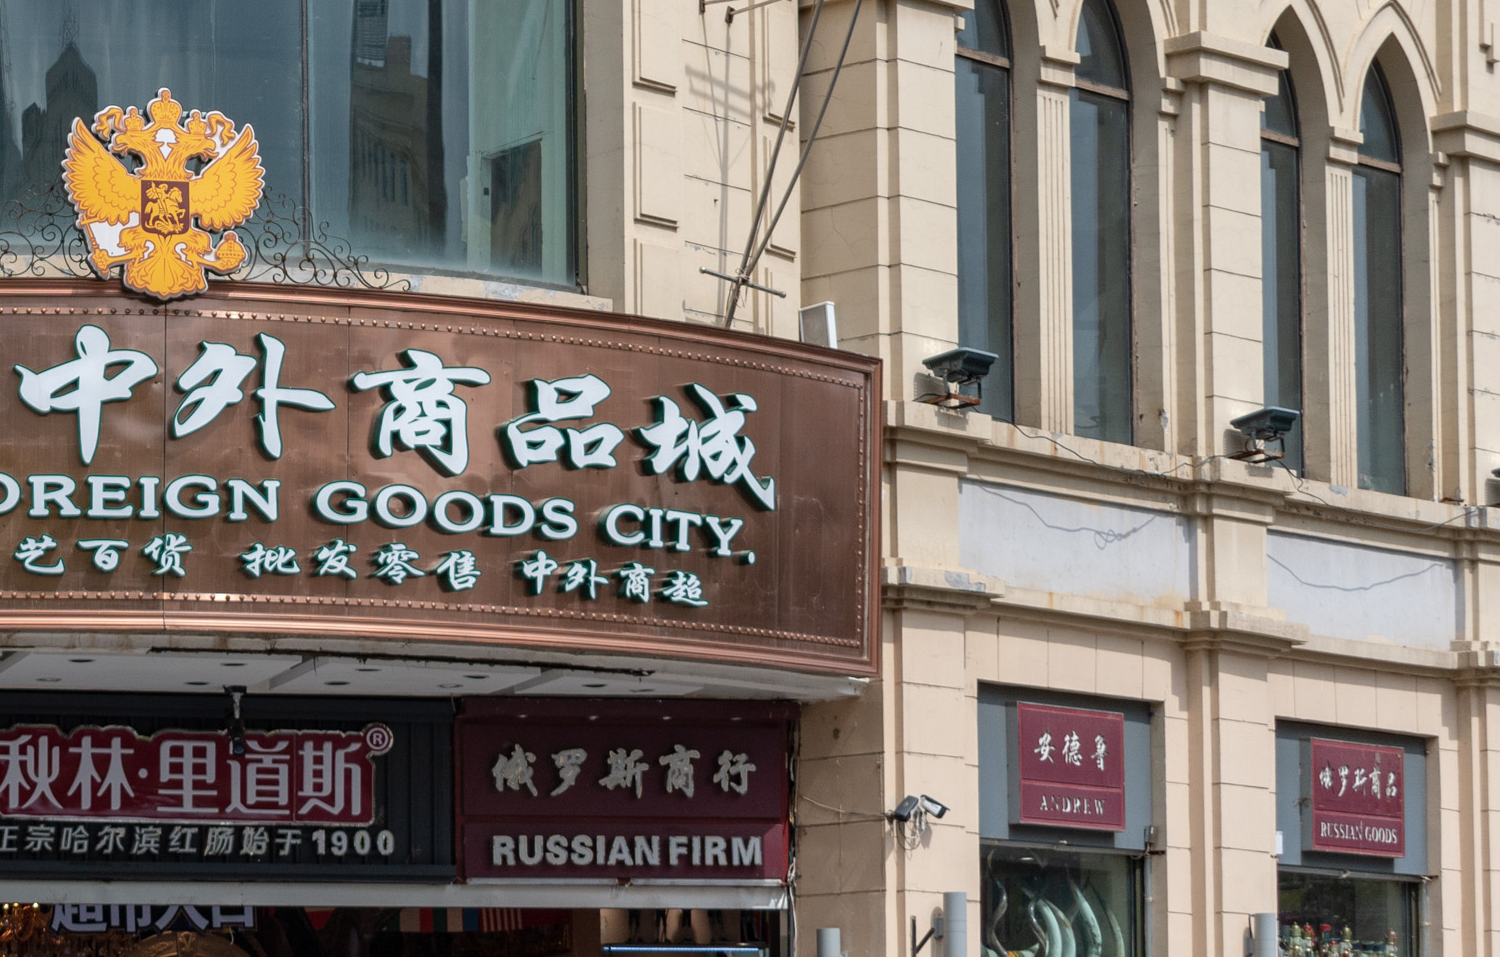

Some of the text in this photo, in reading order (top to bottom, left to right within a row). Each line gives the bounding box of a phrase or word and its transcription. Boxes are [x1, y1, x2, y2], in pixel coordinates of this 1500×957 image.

[314, 481, 579, 540] GOODS
[242, 540, 482, 592] 批发零售
[520, 549, 710, 607] 中外商超
[1033, 730, 1109, 772] 安德鲁
[491, 743, 757, 799] 俄罗斯商行
[1318, 764, 1398, 800] 俄罗斯商品
[1039, 793, 1106, 815] ANDREW
[492, 834, 763, 867] RUSSIAN FIRM
[1320, 821, 1398, 844] RUSSIAN GOODS
